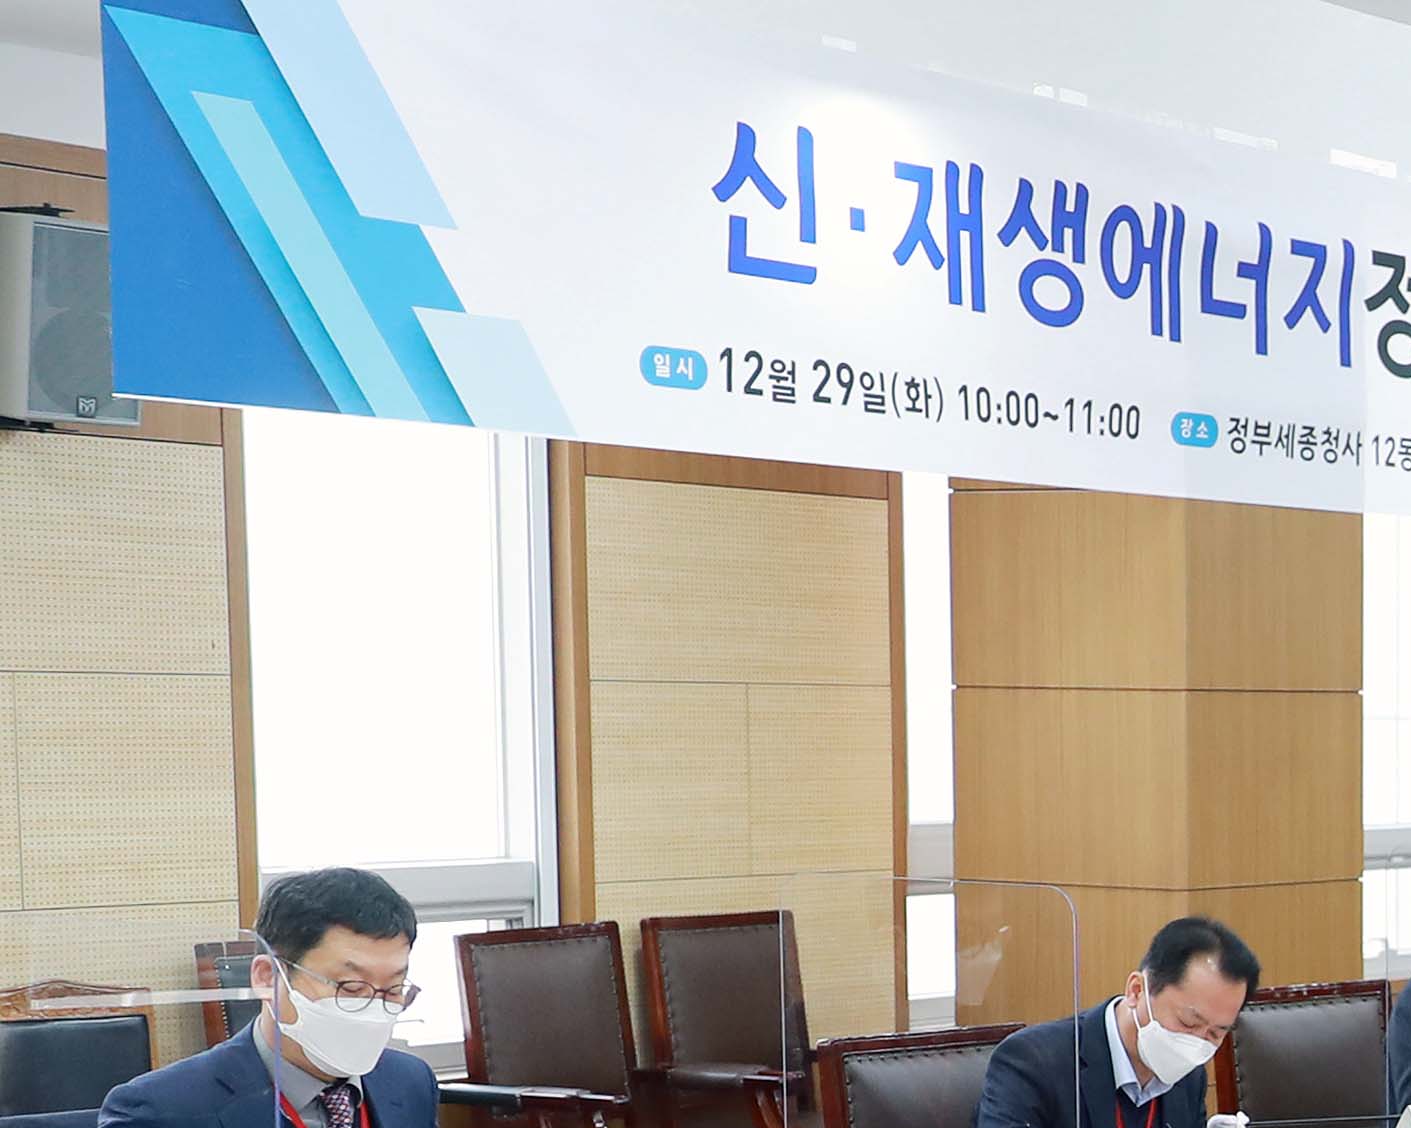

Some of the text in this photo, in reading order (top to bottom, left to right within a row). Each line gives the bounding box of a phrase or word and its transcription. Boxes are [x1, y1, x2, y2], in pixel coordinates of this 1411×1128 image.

[653, 352, 695, 381] 일시
[718, 347, 1141, 440] 12월 29일(화) 10:00~11:00
[1179, 418, 1210, 439] 장소
[1227, 415, 1364, 467] 정부세종청사
